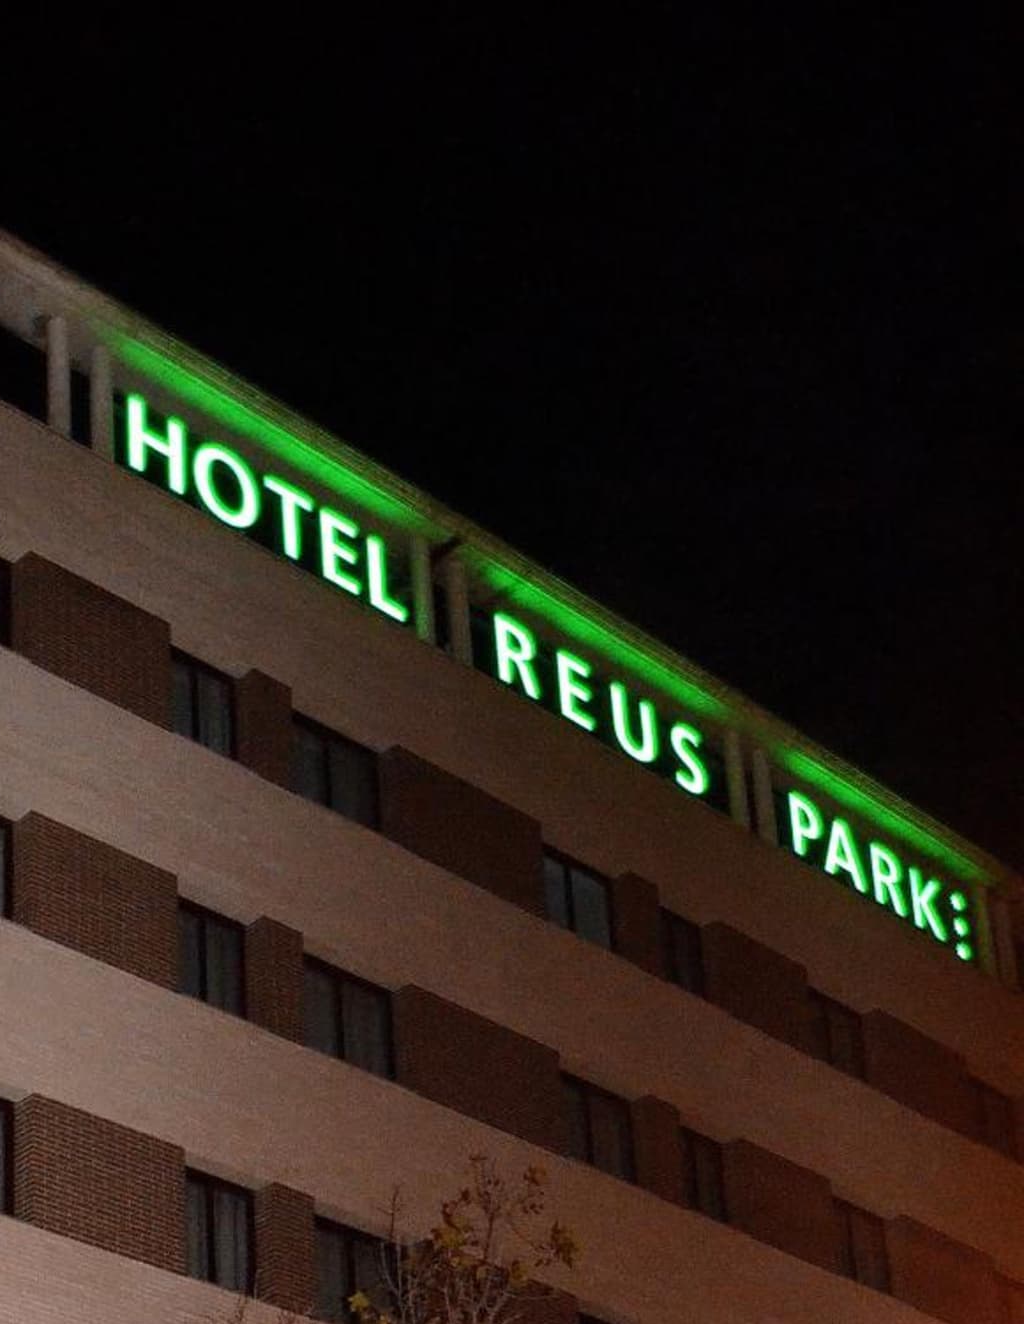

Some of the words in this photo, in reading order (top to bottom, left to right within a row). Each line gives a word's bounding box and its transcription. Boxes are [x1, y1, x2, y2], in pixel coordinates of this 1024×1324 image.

[124, 394, 409, 625] HOTEL
[491, 612, 710, 798] REUS
[786, 790, 949, 944] PARK
